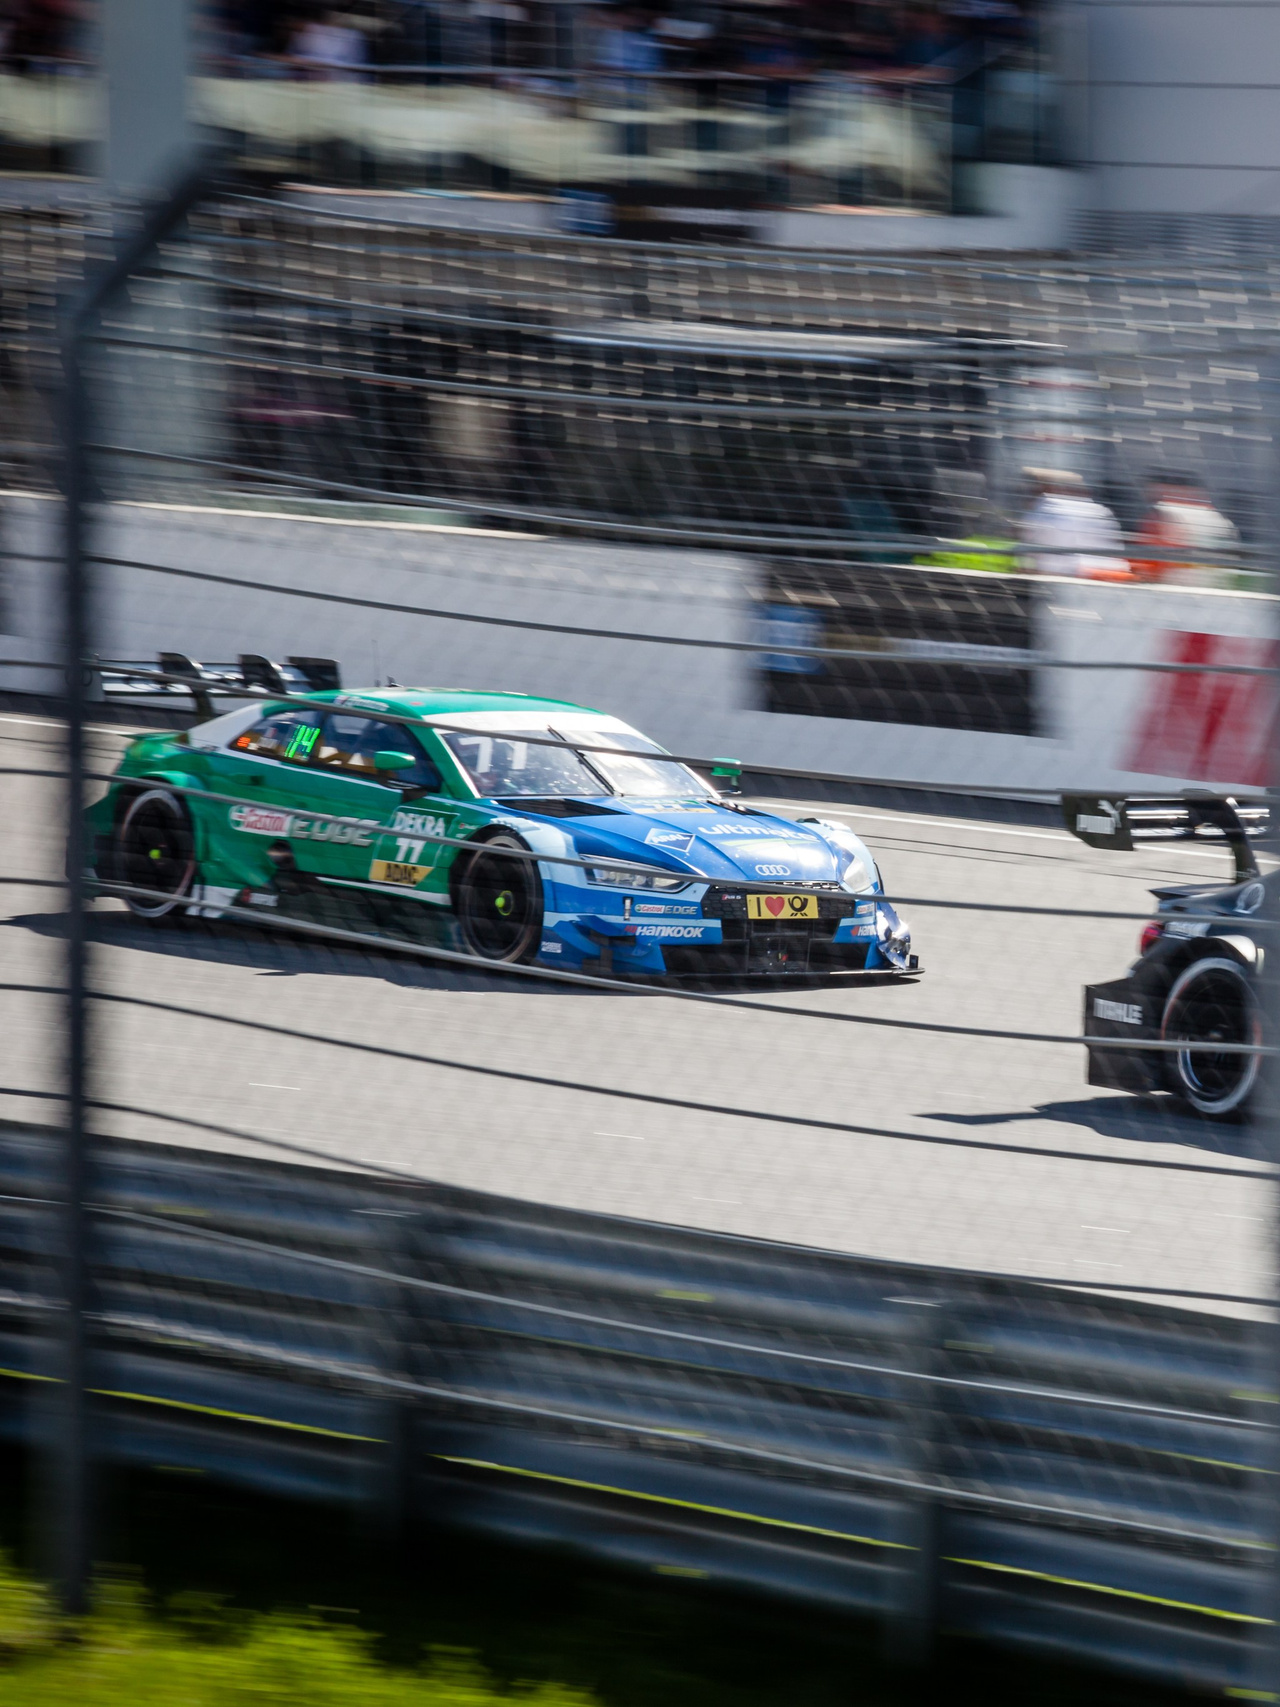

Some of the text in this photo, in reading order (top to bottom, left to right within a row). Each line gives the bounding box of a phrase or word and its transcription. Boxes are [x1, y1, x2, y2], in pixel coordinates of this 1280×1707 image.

[292, 809, 381, 847] EDGE
[392, 811, 445, 837] DEKRA
[651, 832, 690, 845] ARAL
[641, 904, 698, 914] Castrol EDGE
